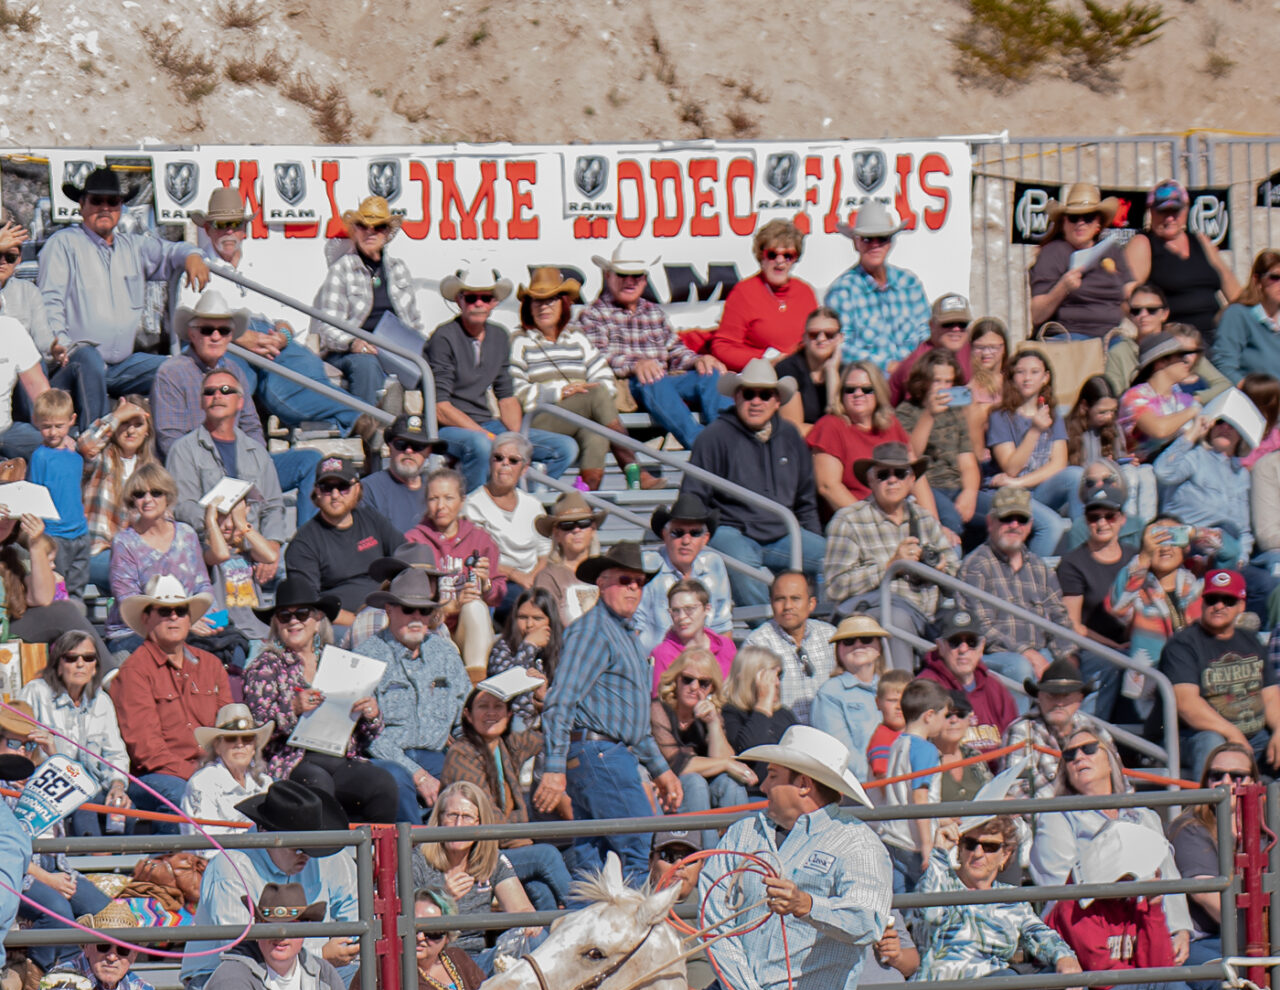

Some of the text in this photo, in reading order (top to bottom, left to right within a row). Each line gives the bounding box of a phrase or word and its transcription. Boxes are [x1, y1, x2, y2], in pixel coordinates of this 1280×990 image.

[569, 202, 613, 211] RAM
[759, 200, 801, 209] RAM
[271, 209, 315, 218] RAM
[33, 768, 76, 805] 135
